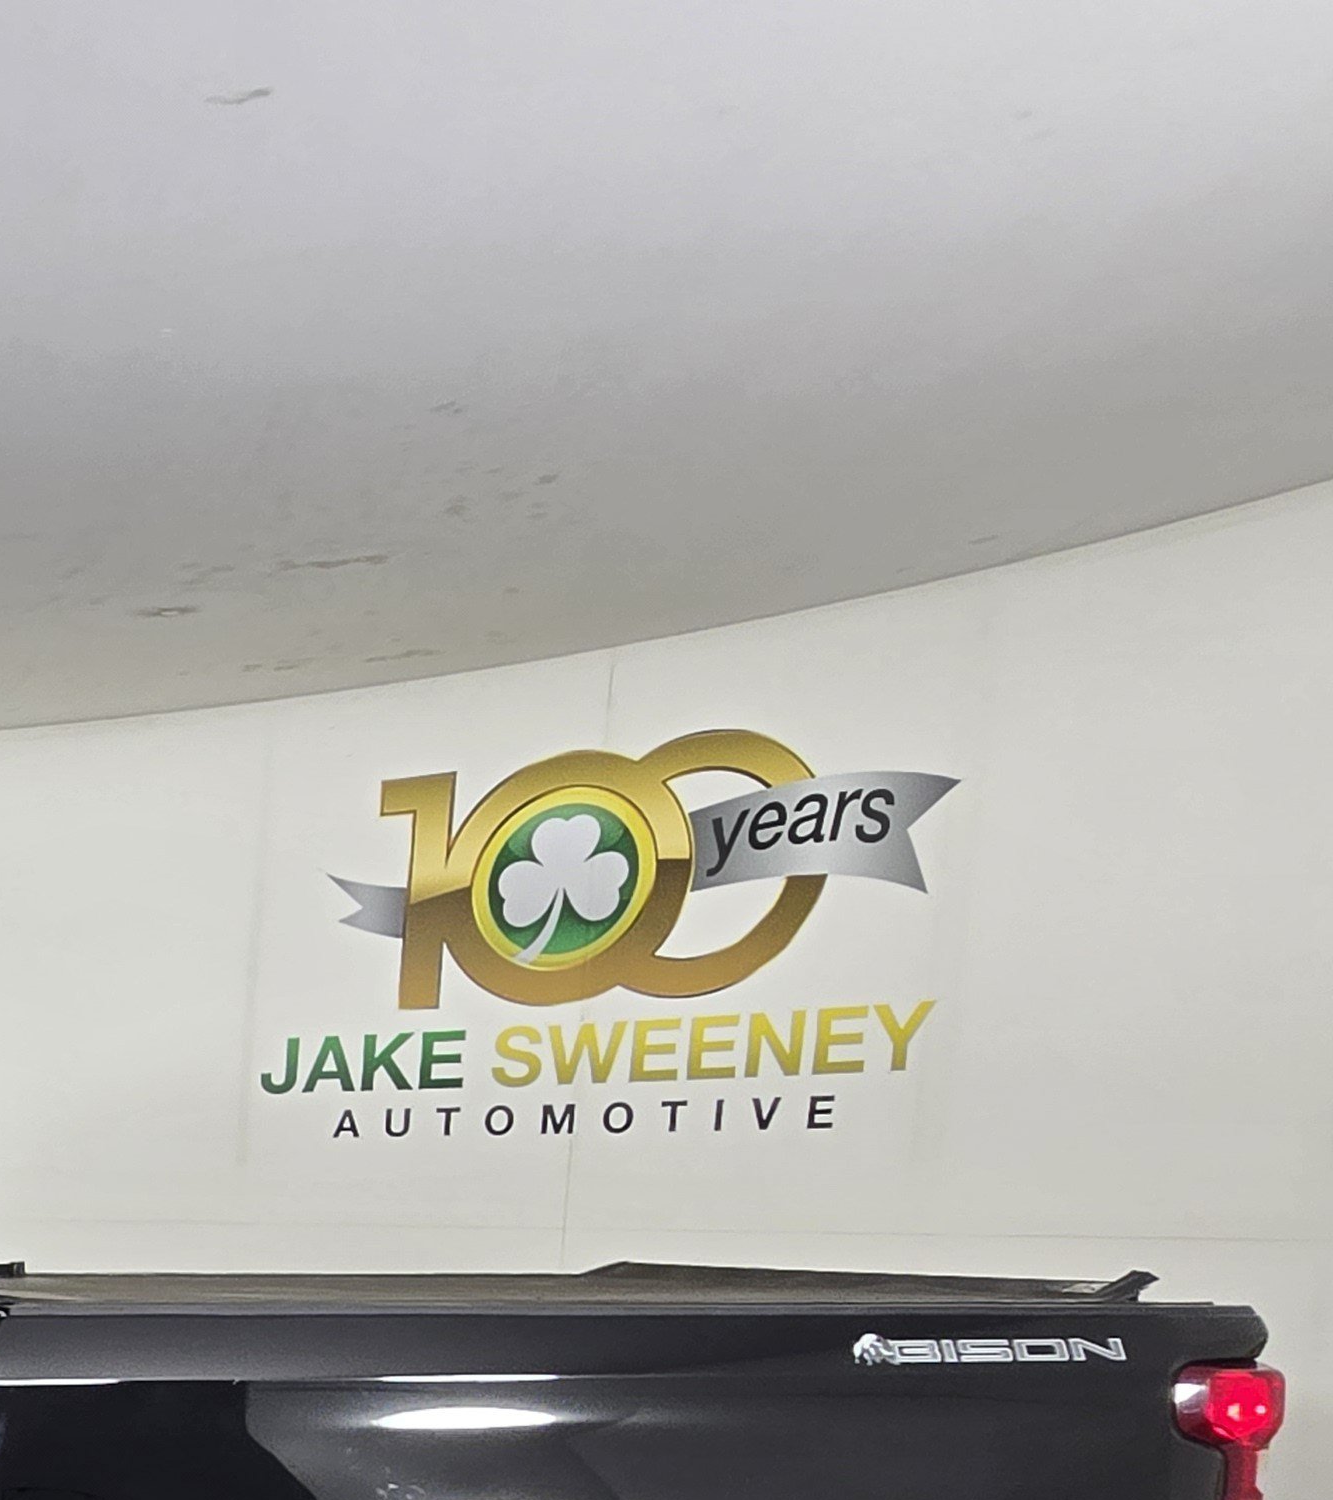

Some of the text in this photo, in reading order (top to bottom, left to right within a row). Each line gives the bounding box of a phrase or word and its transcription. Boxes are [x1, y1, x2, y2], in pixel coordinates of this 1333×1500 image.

[379, 728, 829, 1010] 100
[705, 783, 896, 878] years
[260, 999, 937, 1096] JAKE SWEENEY
[332, 1094, 837, 1140] AUTOMOTIVE
[890, 1337, 1128, 1363] BISON
